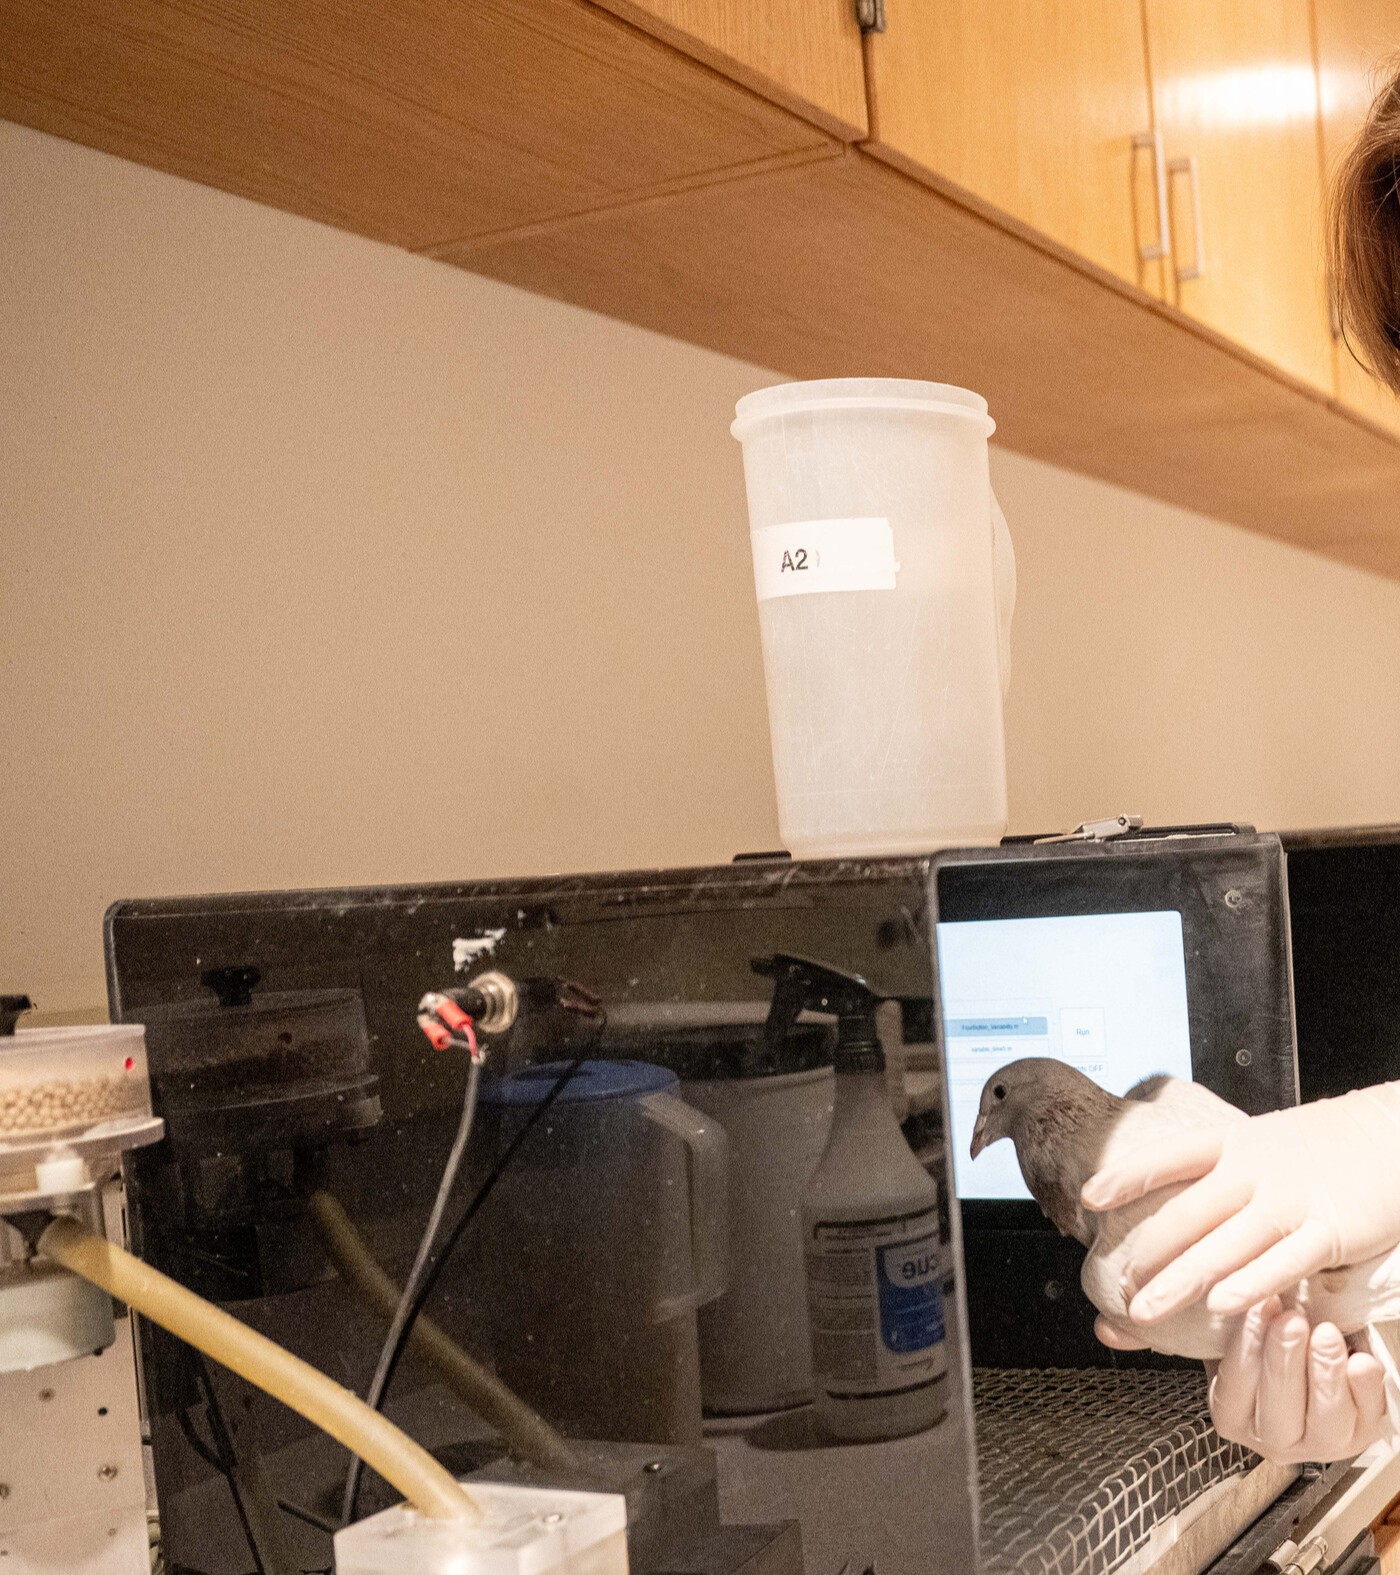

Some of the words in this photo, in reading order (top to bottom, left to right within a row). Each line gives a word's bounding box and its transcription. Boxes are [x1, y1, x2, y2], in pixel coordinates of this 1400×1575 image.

[781, 548, 808, 572] A2
[1076, 1028, 1090, 1036] Run
[1089, 1064, 1103, 1072] OFF
